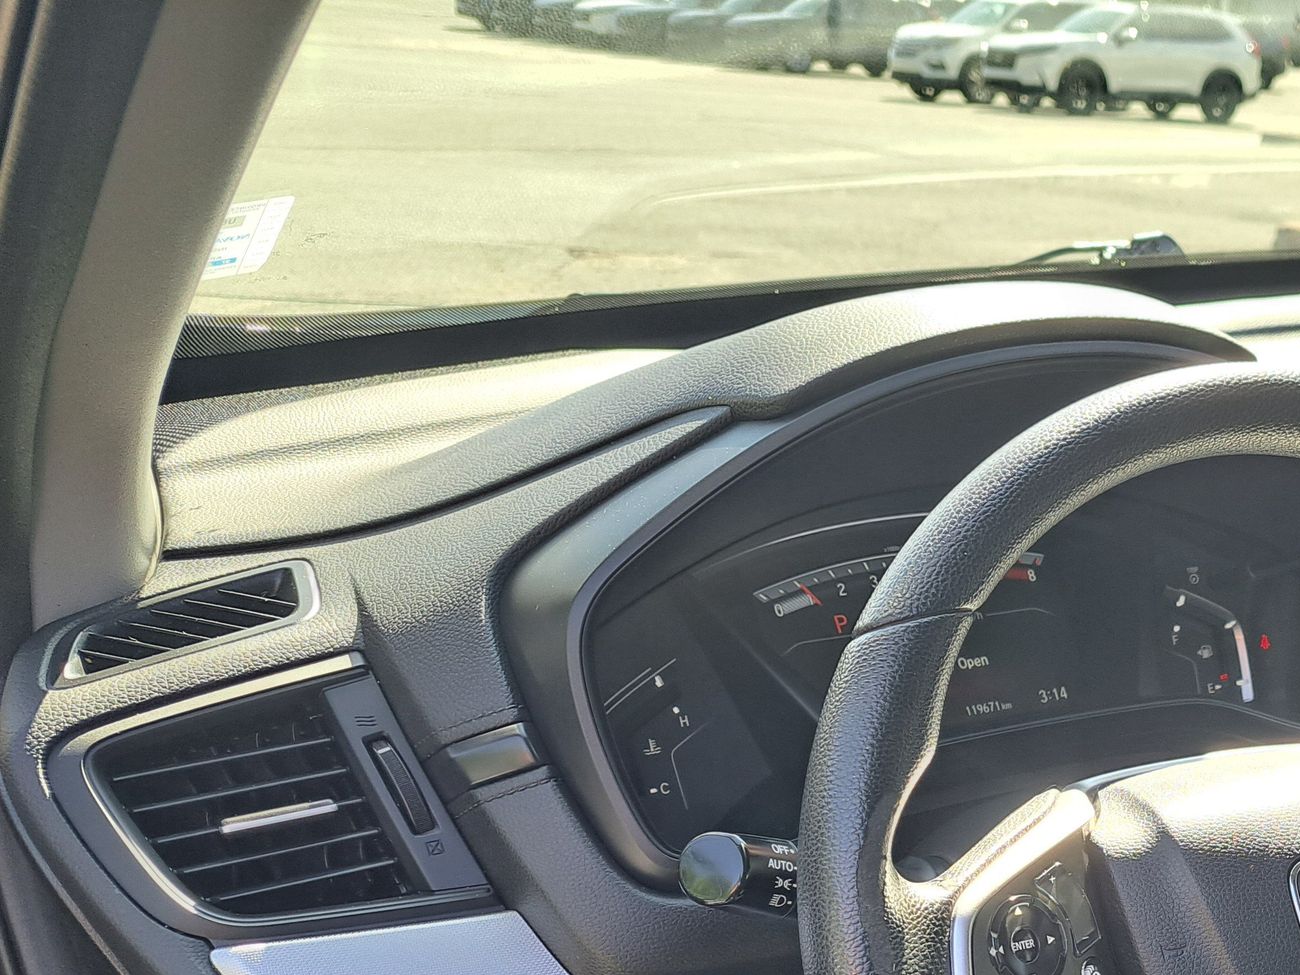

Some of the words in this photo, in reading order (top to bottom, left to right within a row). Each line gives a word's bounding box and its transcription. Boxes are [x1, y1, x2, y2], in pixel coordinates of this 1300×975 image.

[1027, 569, 1037, 582] 8
[774, 603, 784, 617] 0
[837, 582, 847, 597] 2
[833, 614, 848, 634] P
[1172, 634, 1179, 646] F
[957, 655, 989, 670] Open
[1038, 686, 1068, 703] 3:14
[1207, 683, 1216, 694] E
[679, 715, 690, 727] H
[660, 782, 670, 795] C
[771, 843, 789, 855] OFF
[767, 858, 794, 872] AUTO
[1011, 938, 1035, 952] ENTER
